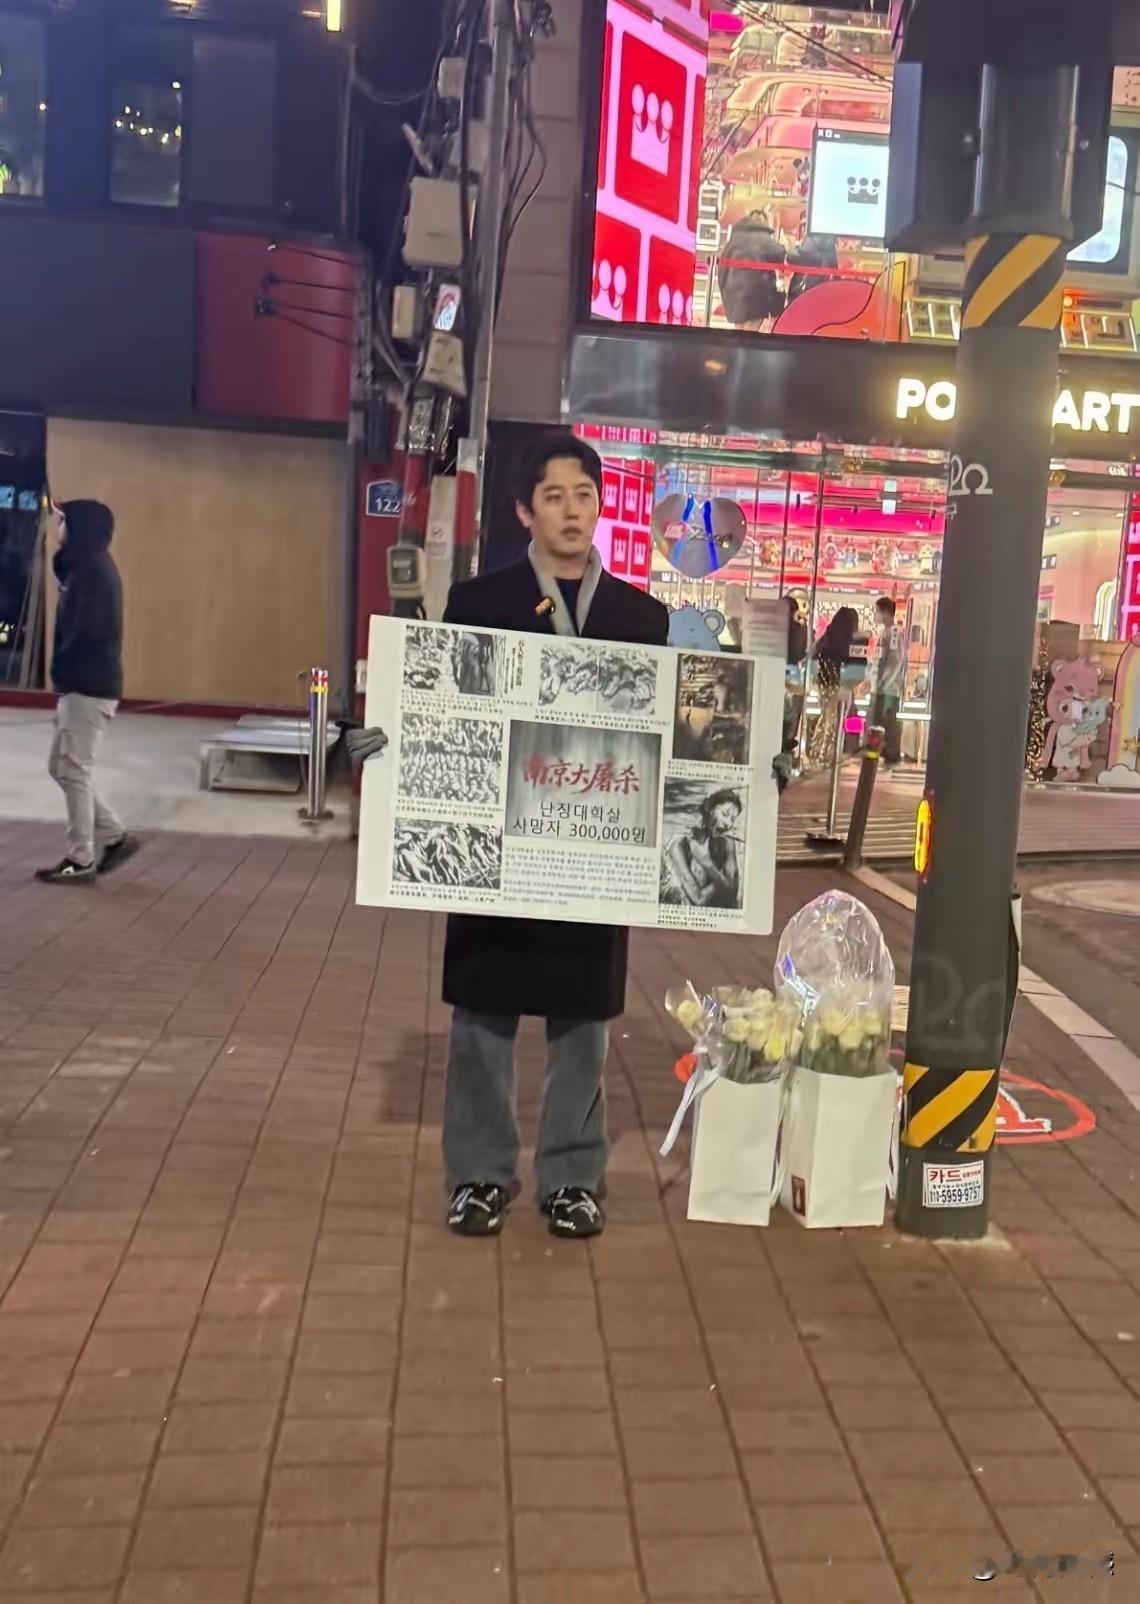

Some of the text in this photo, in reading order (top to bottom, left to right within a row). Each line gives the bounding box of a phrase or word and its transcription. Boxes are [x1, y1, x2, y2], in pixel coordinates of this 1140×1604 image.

[896, 378, 1140, 434] PO ART
[375, 497, 402, 513] 122
[523, 754, 642, 796] 南京大屠杀
[513, 817, 648, 846] 사망자 300,000명
[929, 1169, 962, 1184] 카드
